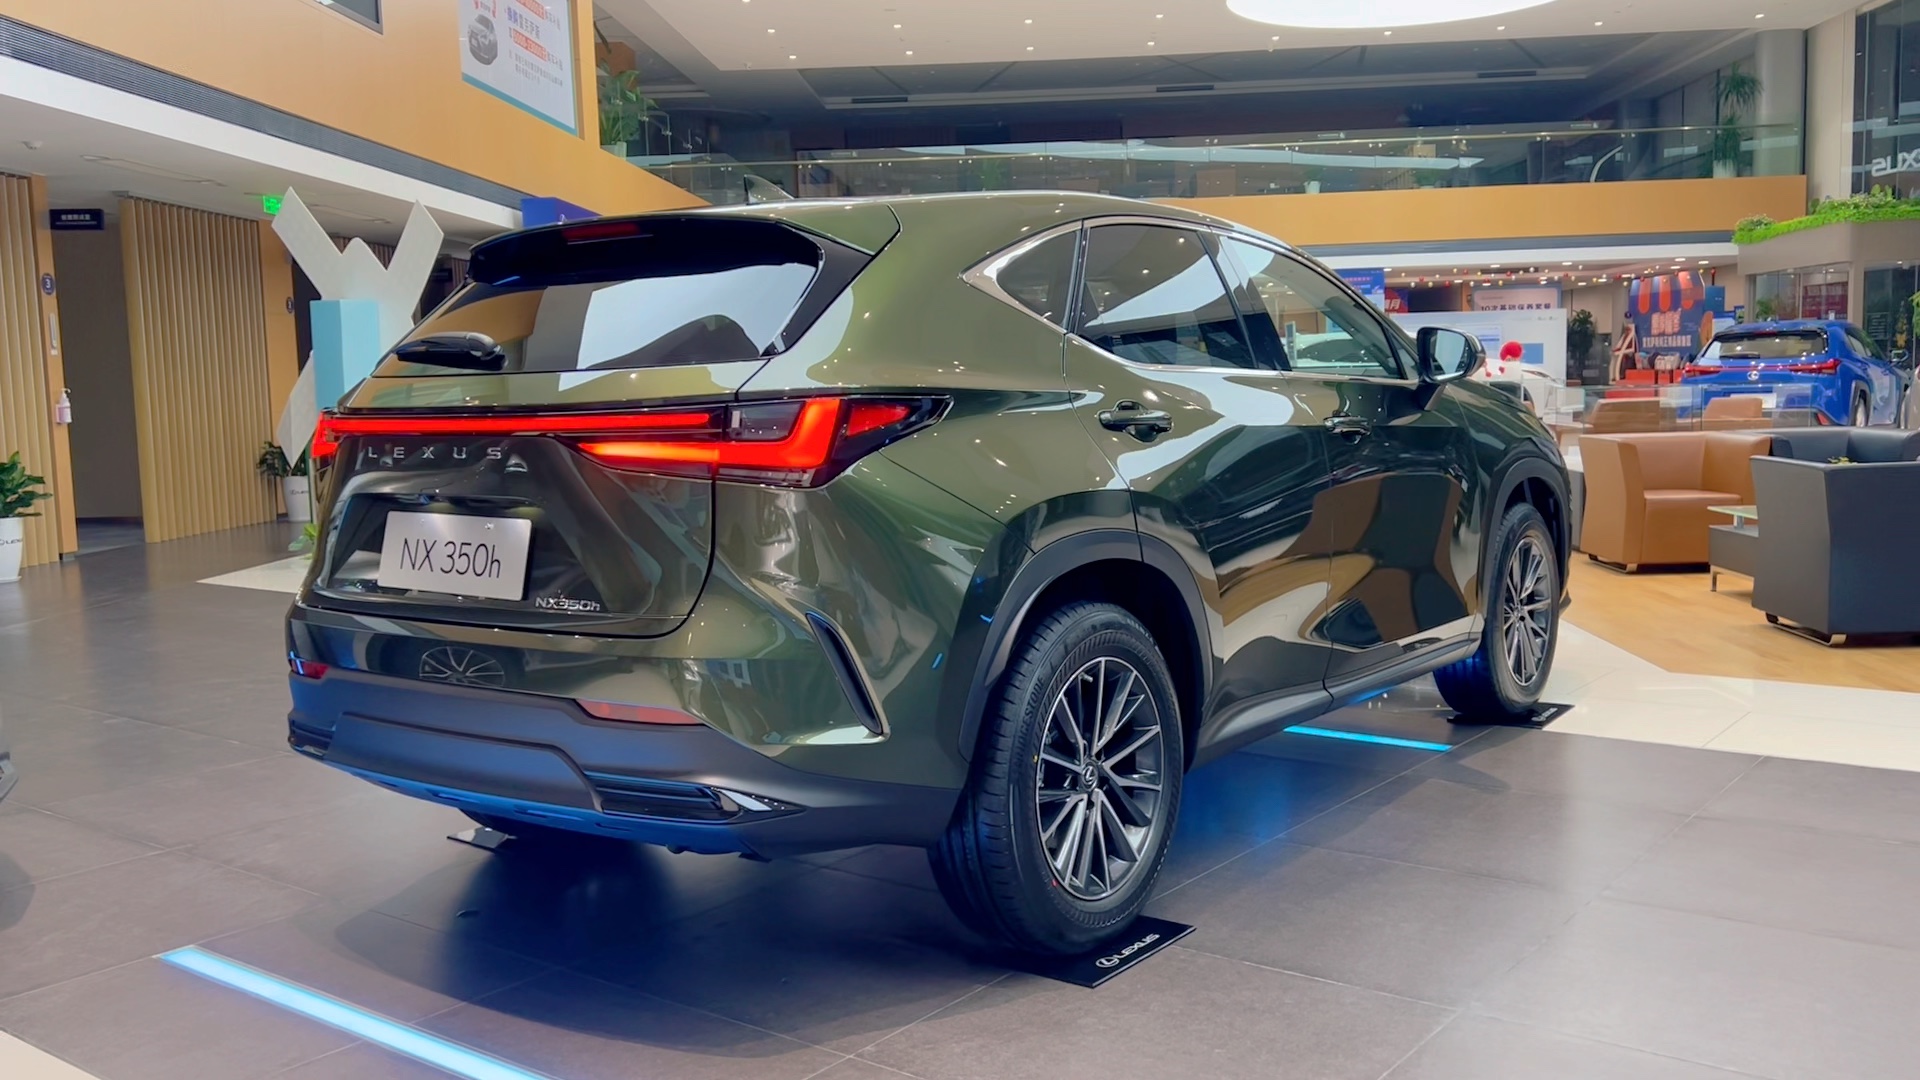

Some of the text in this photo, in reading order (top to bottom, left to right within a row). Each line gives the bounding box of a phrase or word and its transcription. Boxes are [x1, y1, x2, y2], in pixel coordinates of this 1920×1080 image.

[367, 446, 502, 460] LEXUS
[400, 538, 502, 579] NX 350h
[1114, 933, 1160, 959] LEXUS
